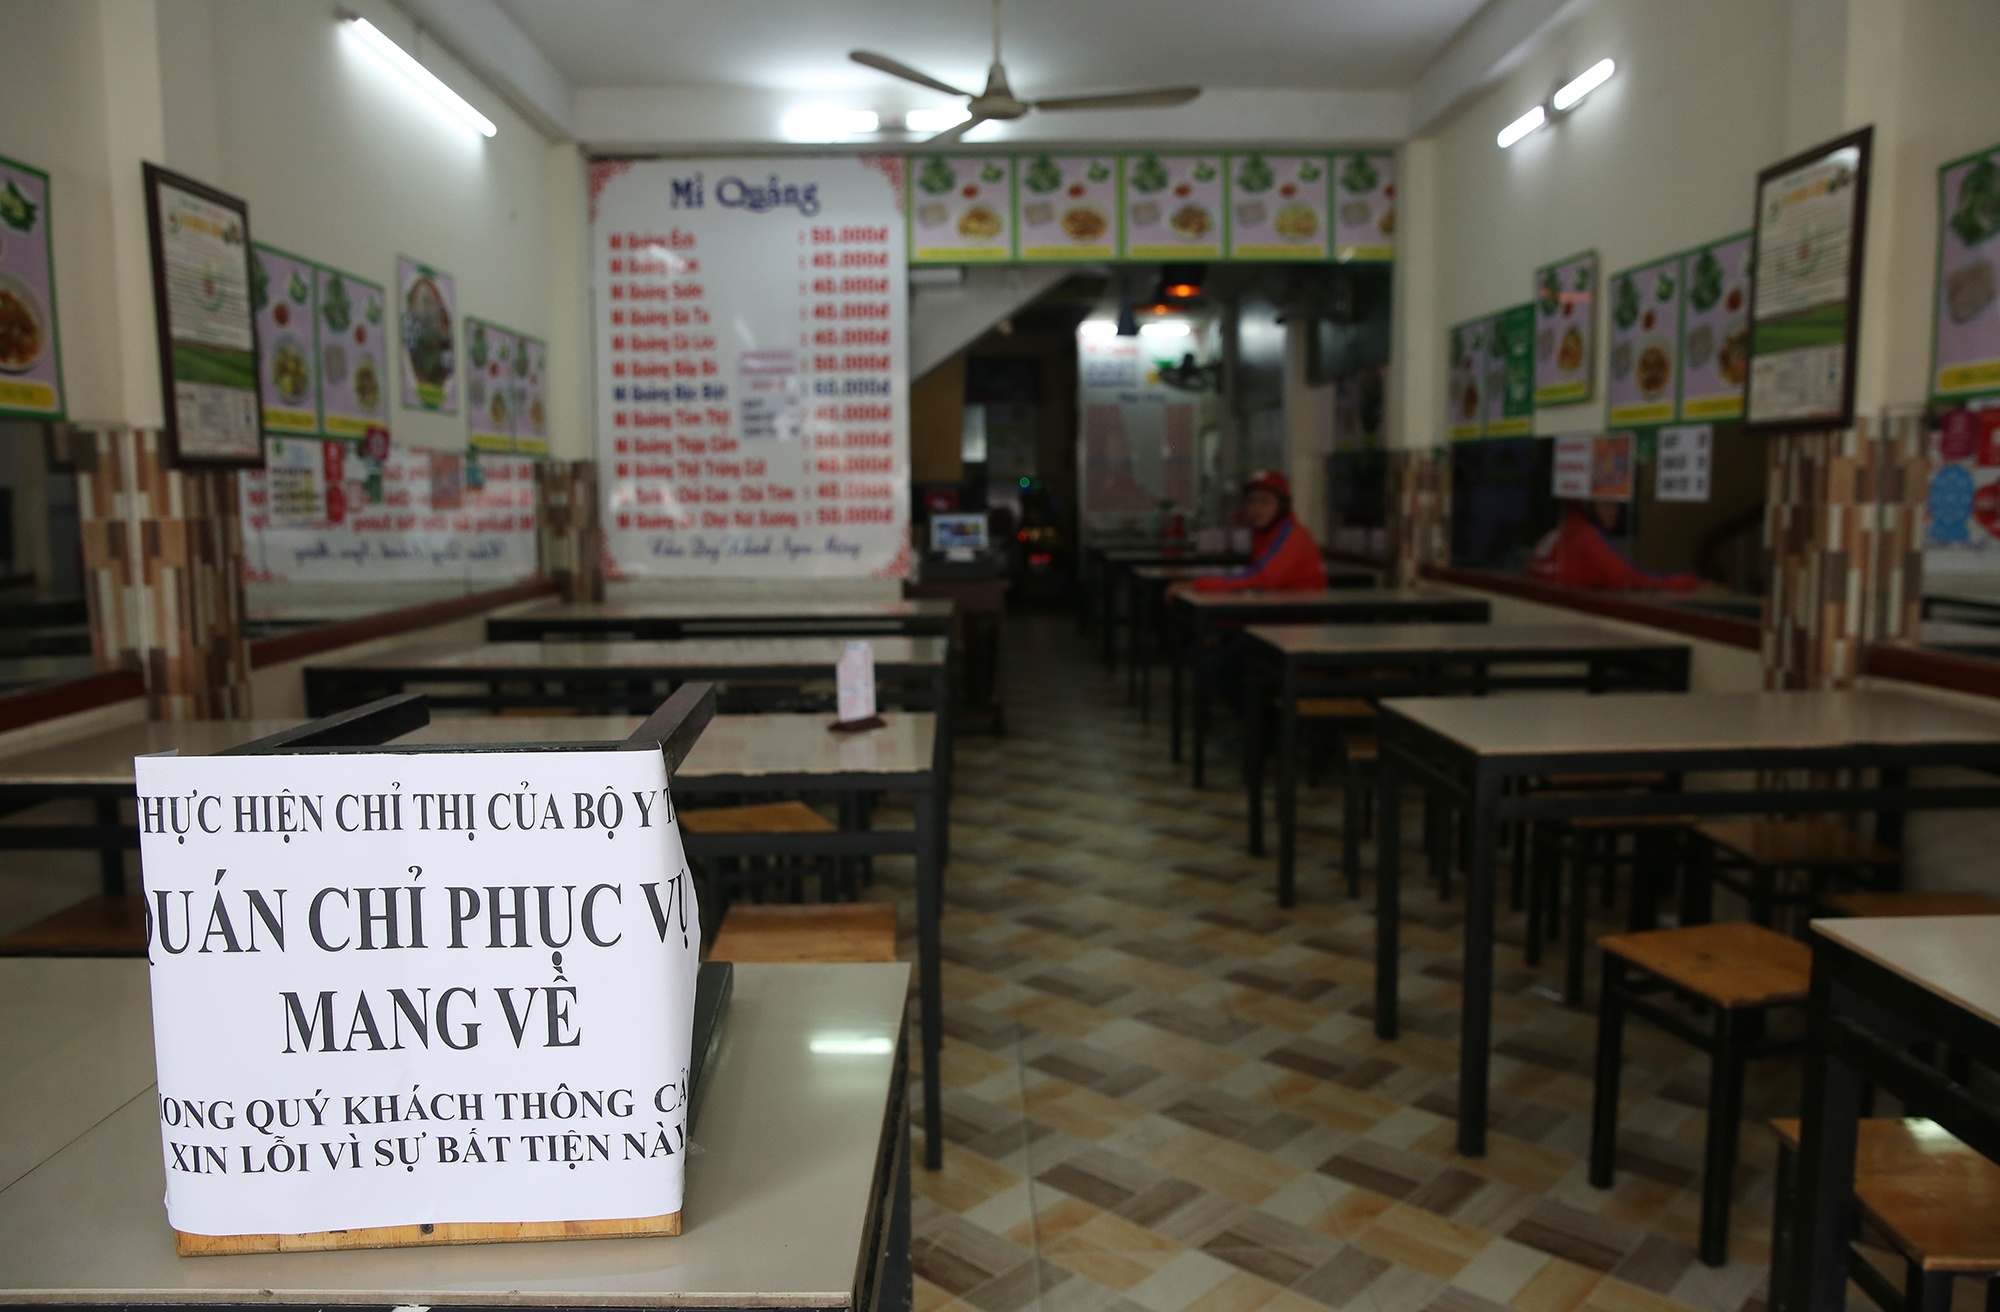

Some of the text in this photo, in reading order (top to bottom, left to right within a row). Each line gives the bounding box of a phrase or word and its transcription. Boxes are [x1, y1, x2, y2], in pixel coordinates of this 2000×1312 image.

[716, 174, 822, 218] Quảng
[137, 780, 676, 846] HỰC HIỆN CHỈ THỊ CỦA BỘ Y T
[308, 865, 429, 954] CHỈ
[444, 882, 622, 968] PHỤC
[640, 867, 690, 950] VỤ
[278, 965, 582, 1054] MANG VỀ
[159, 1067, 689, 1137] ONG QUÝ KHÁCH THÔNG CẢ
[170, 1141, 229, 1175] XIN
[242, 1133, 309, 1174] LỖI
[320, 1134, 362, 1170] VÌ
[374, 1132, 427, 1173] SỰ
[437, 1127, 511, 1164] BẤT
[520, 1130, 611, 1170] TIỆN
